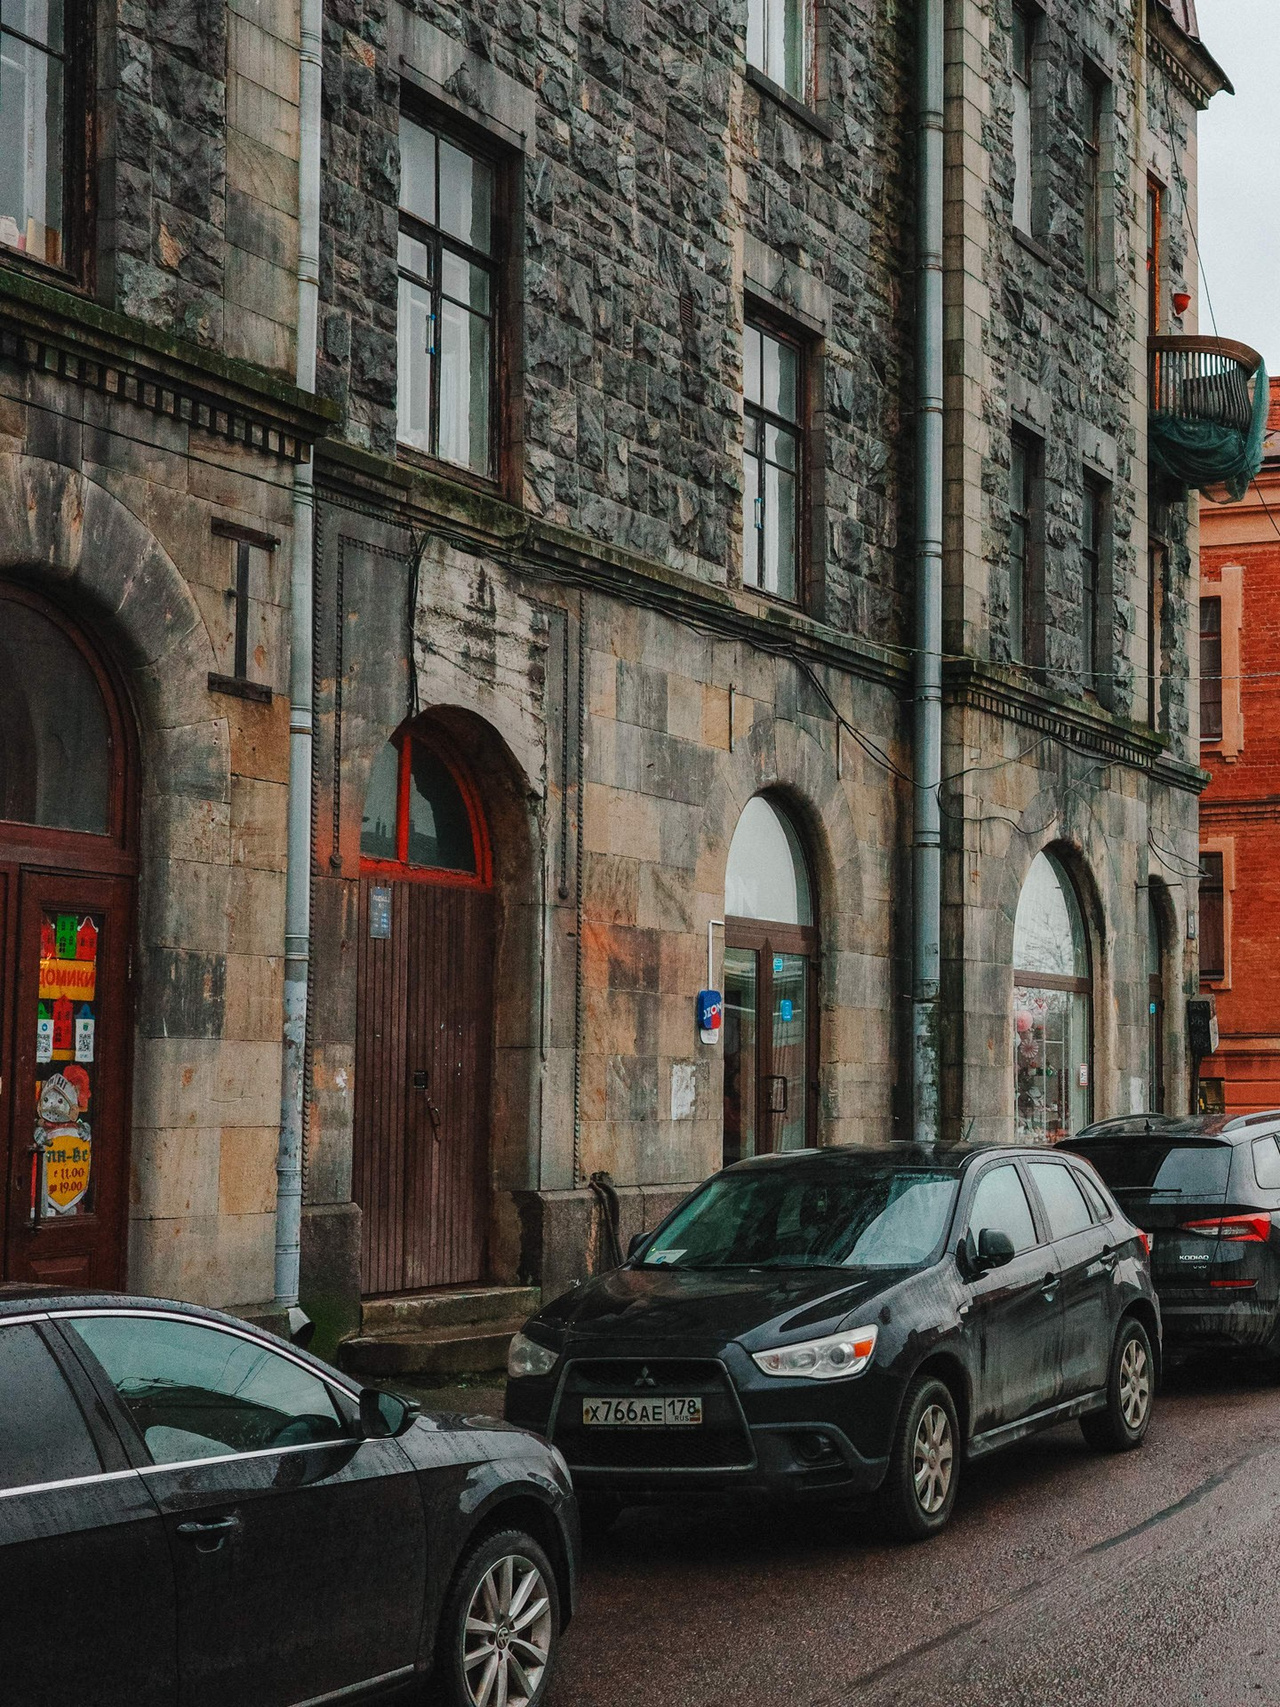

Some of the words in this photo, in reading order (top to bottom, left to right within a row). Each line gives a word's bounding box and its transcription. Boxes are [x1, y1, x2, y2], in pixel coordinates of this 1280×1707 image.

[61, 1167, 85, 1179] 11.00
[60, 1181, 83, 1193] 19.00
[590, 1401, 663, 1421] Х766АЕ
[668, 1400, 696, 1415] 178
